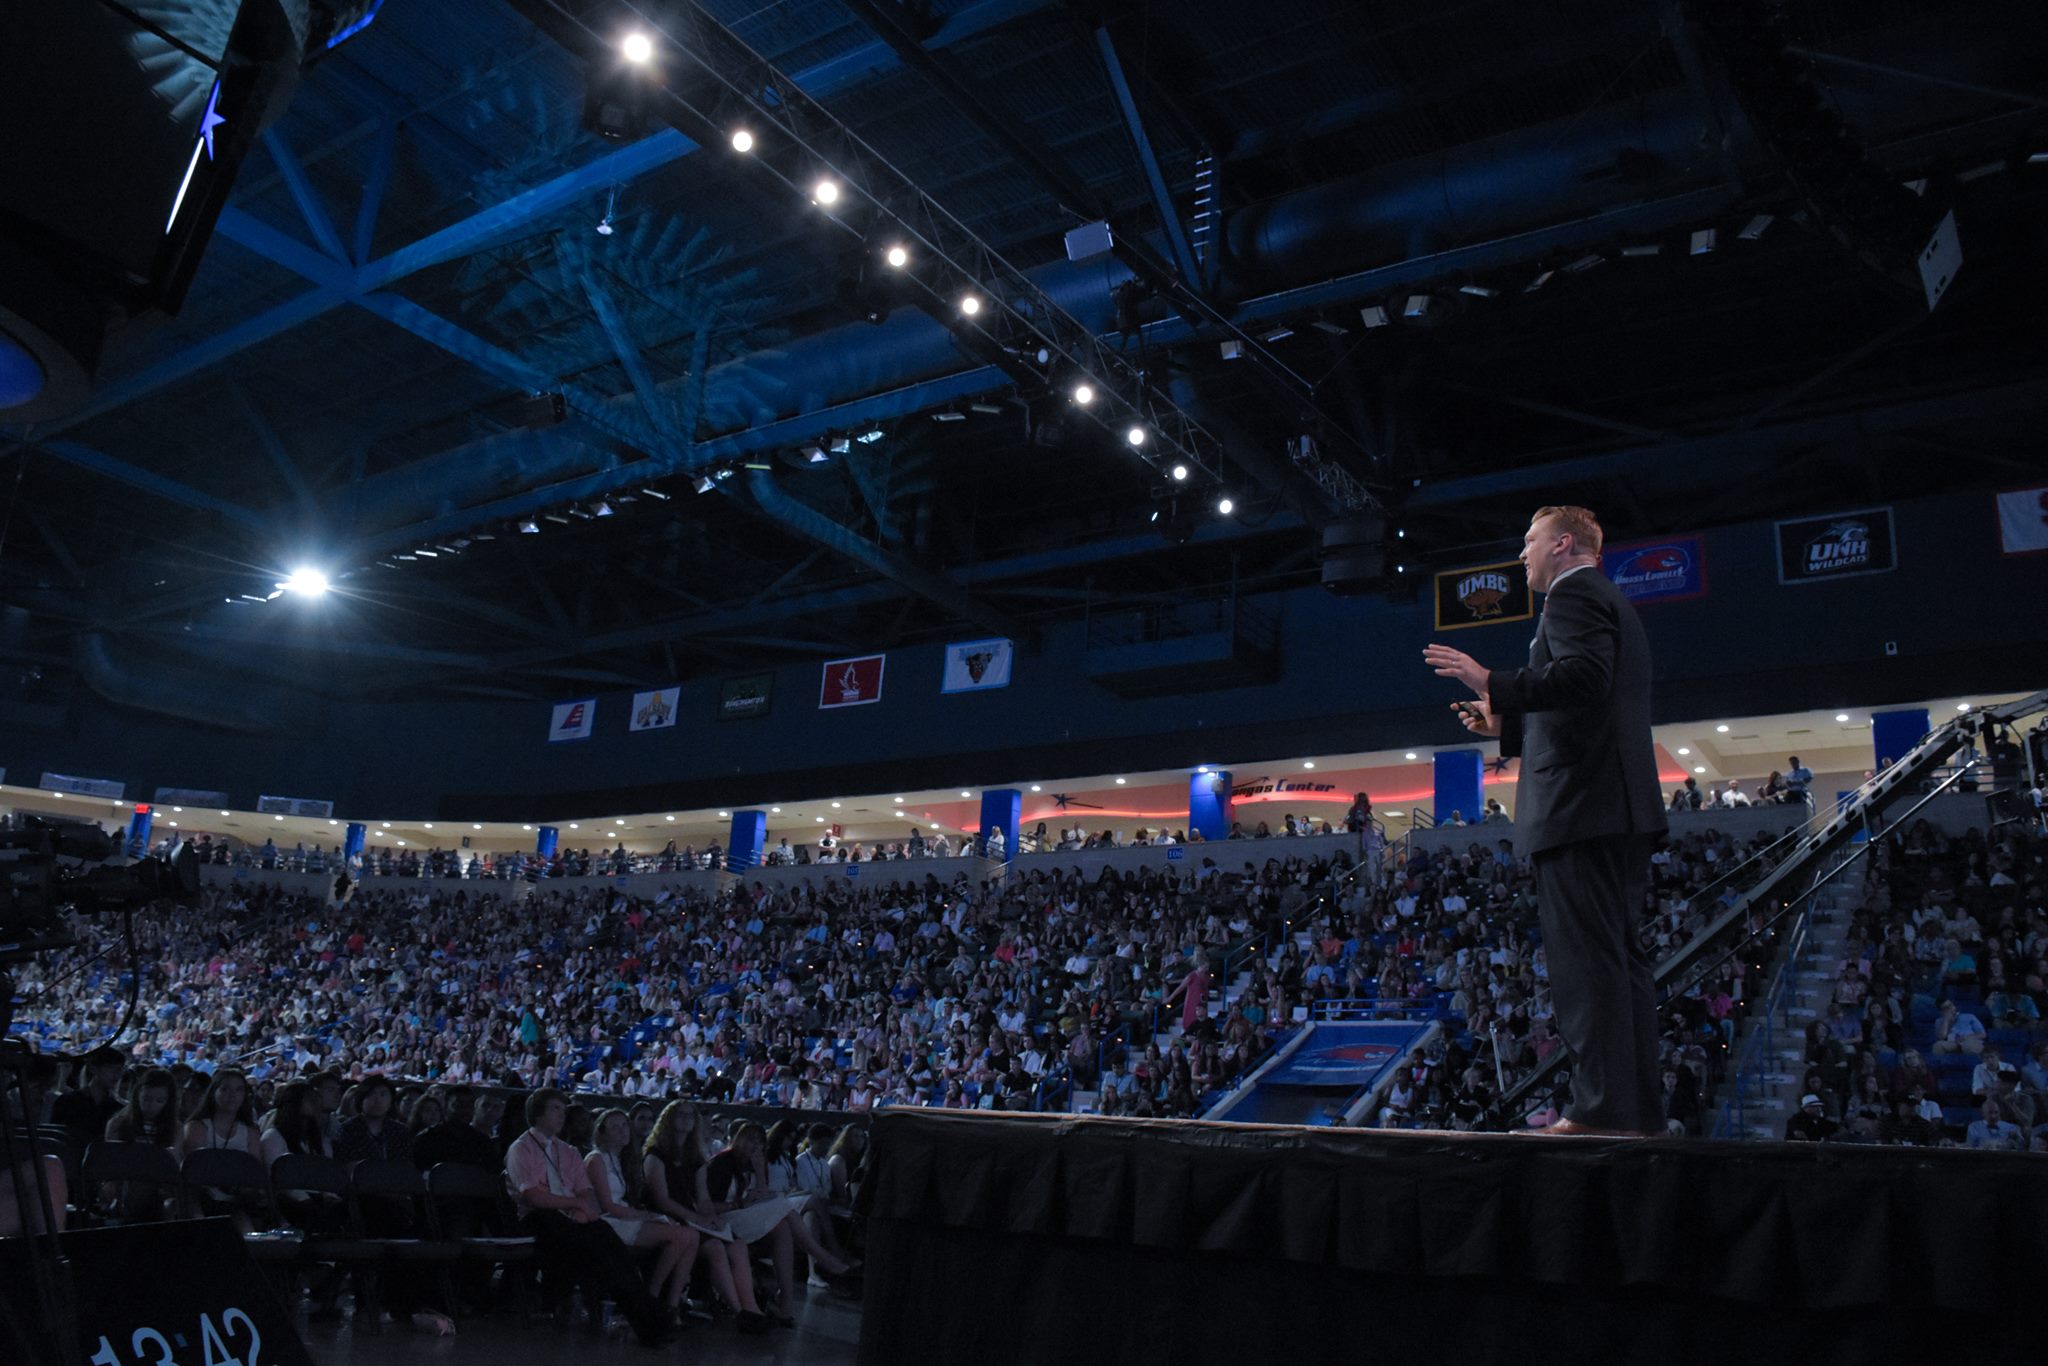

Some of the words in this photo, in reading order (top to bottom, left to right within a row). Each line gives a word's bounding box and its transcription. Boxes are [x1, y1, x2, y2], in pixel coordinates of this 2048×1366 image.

[1810, 541, 1867, 560] UNH
[1458, 573, 1508, 599] UMBC
[1276, 779, 1335, 793] Center
